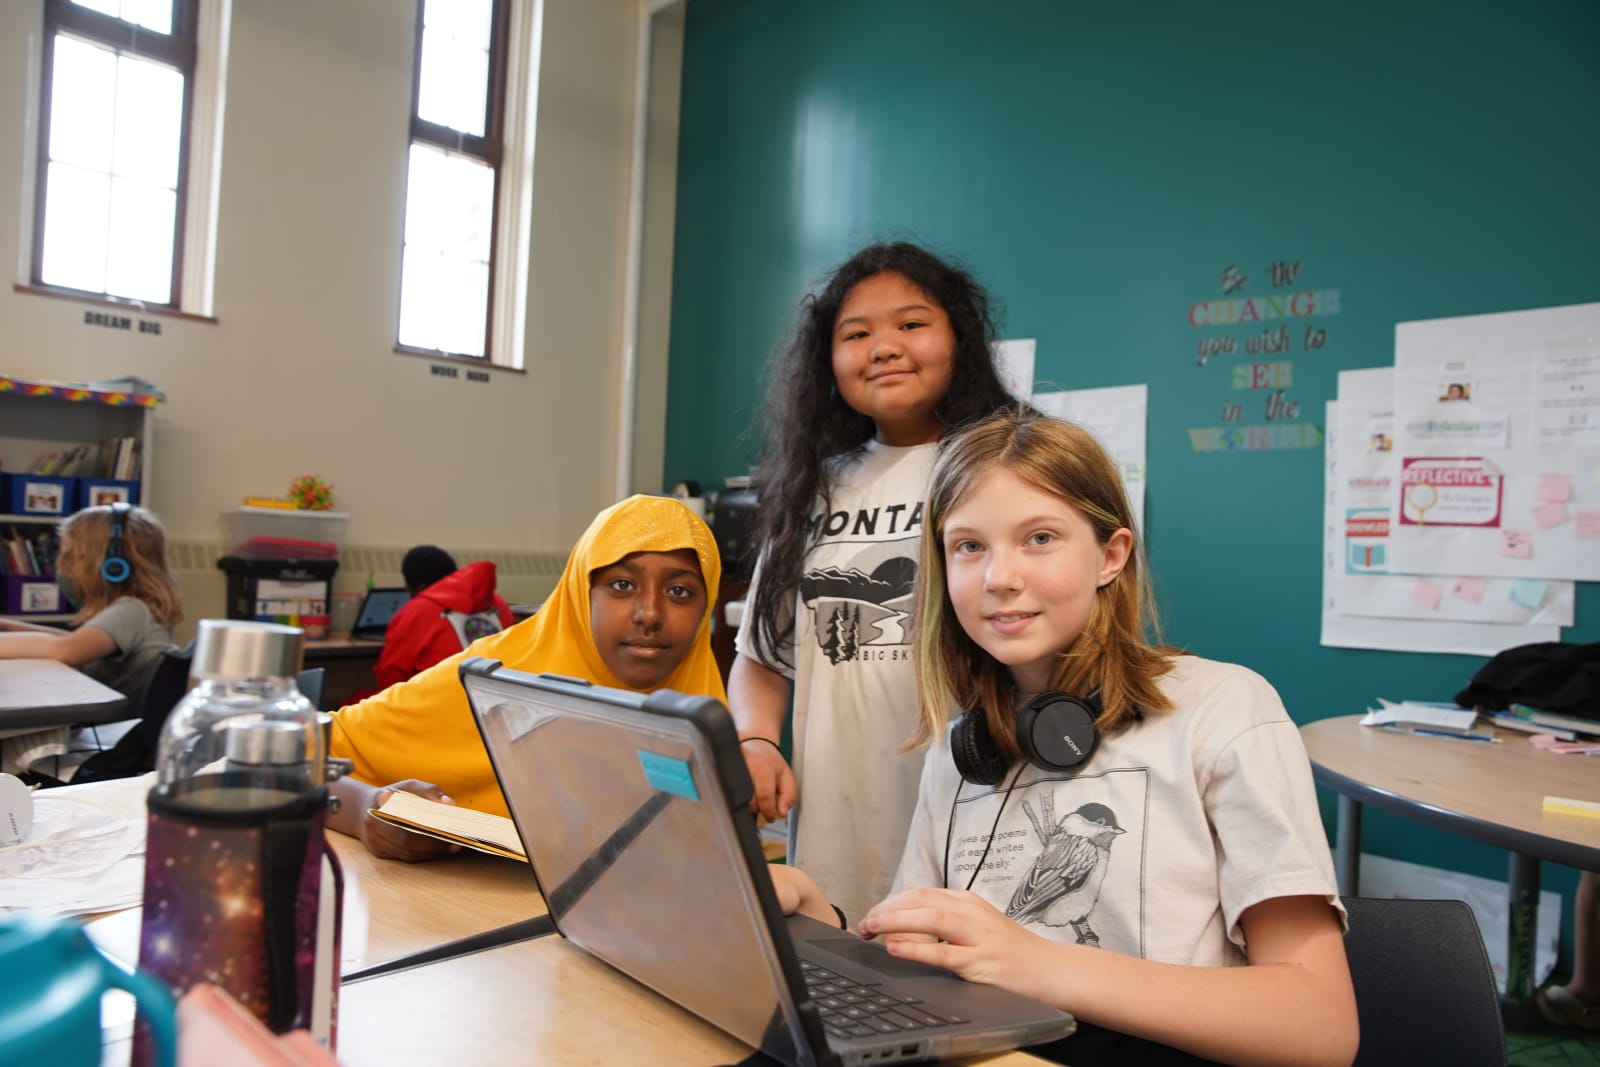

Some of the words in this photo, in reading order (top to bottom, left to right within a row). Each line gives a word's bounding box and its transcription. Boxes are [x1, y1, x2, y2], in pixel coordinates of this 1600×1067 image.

[1188, 289, 1340, 328] CHANGE
[84, 310, 132, 330] DREAM
[138, 319, 163, 336] BIG
[1196, 334, 1237, 366] you
[1246, 324, 1291, 355] wish
[1303, 324, 1328, 351] to
[1231, 361, 1294, 390] SEE
[1221, 400, 1243, 421] in
[1265, 389, 1300, 420] the
[1402, 469, 1482, 484] REFLECTIVE
[806, 501, 924, 541] MONTA
[892, 649, 908, 661] SK
[1063, 735, 1083, 756] SONY
[998, 829, 1028, 843] poems
[967, 846, 994, 857] earh
